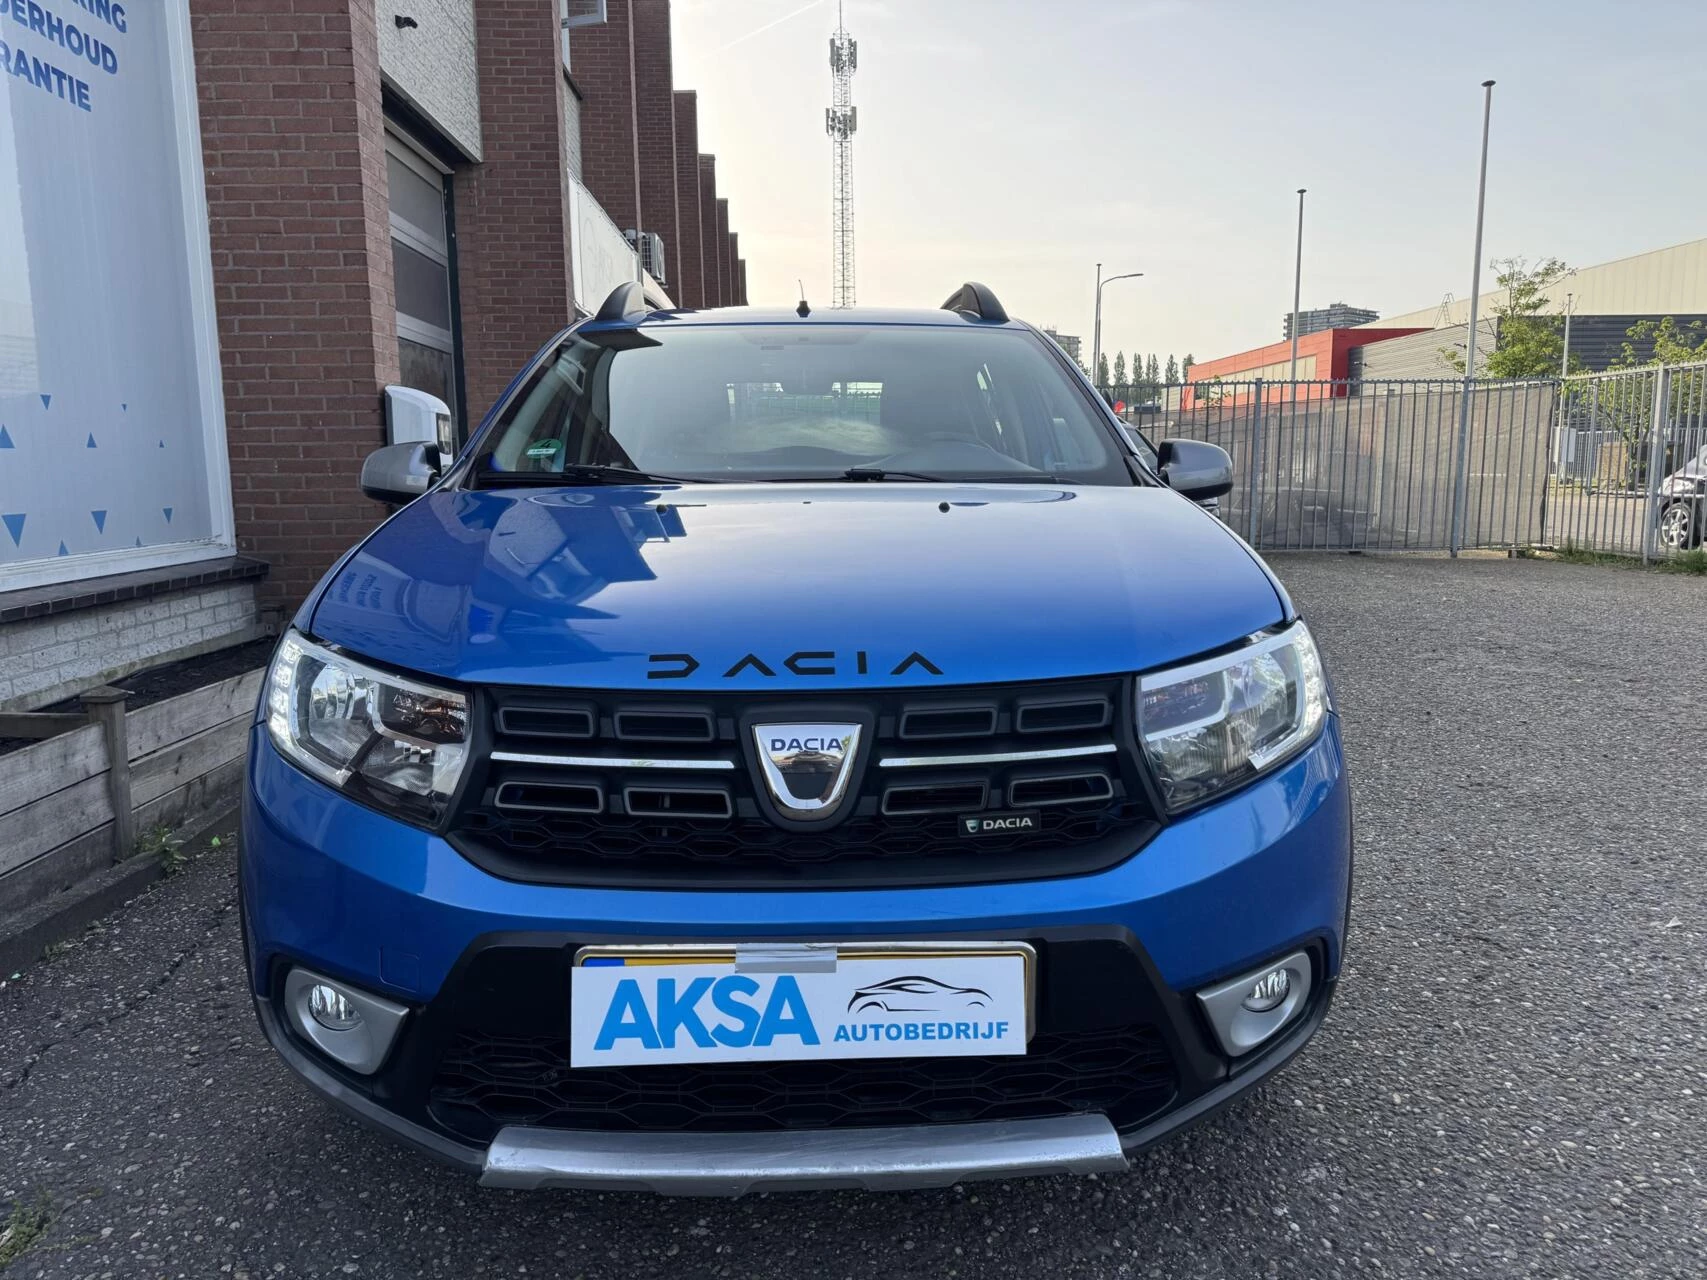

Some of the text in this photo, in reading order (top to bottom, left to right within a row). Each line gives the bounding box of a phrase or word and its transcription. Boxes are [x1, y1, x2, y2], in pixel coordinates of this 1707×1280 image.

[647, 651, 944, 679] DACIA
[770, 738, 844, 751] DACIA
[983, 817, 1033, 830] DACIA
[593, 975, 1010, 1051] AKSA AUTOBEDRIJF
